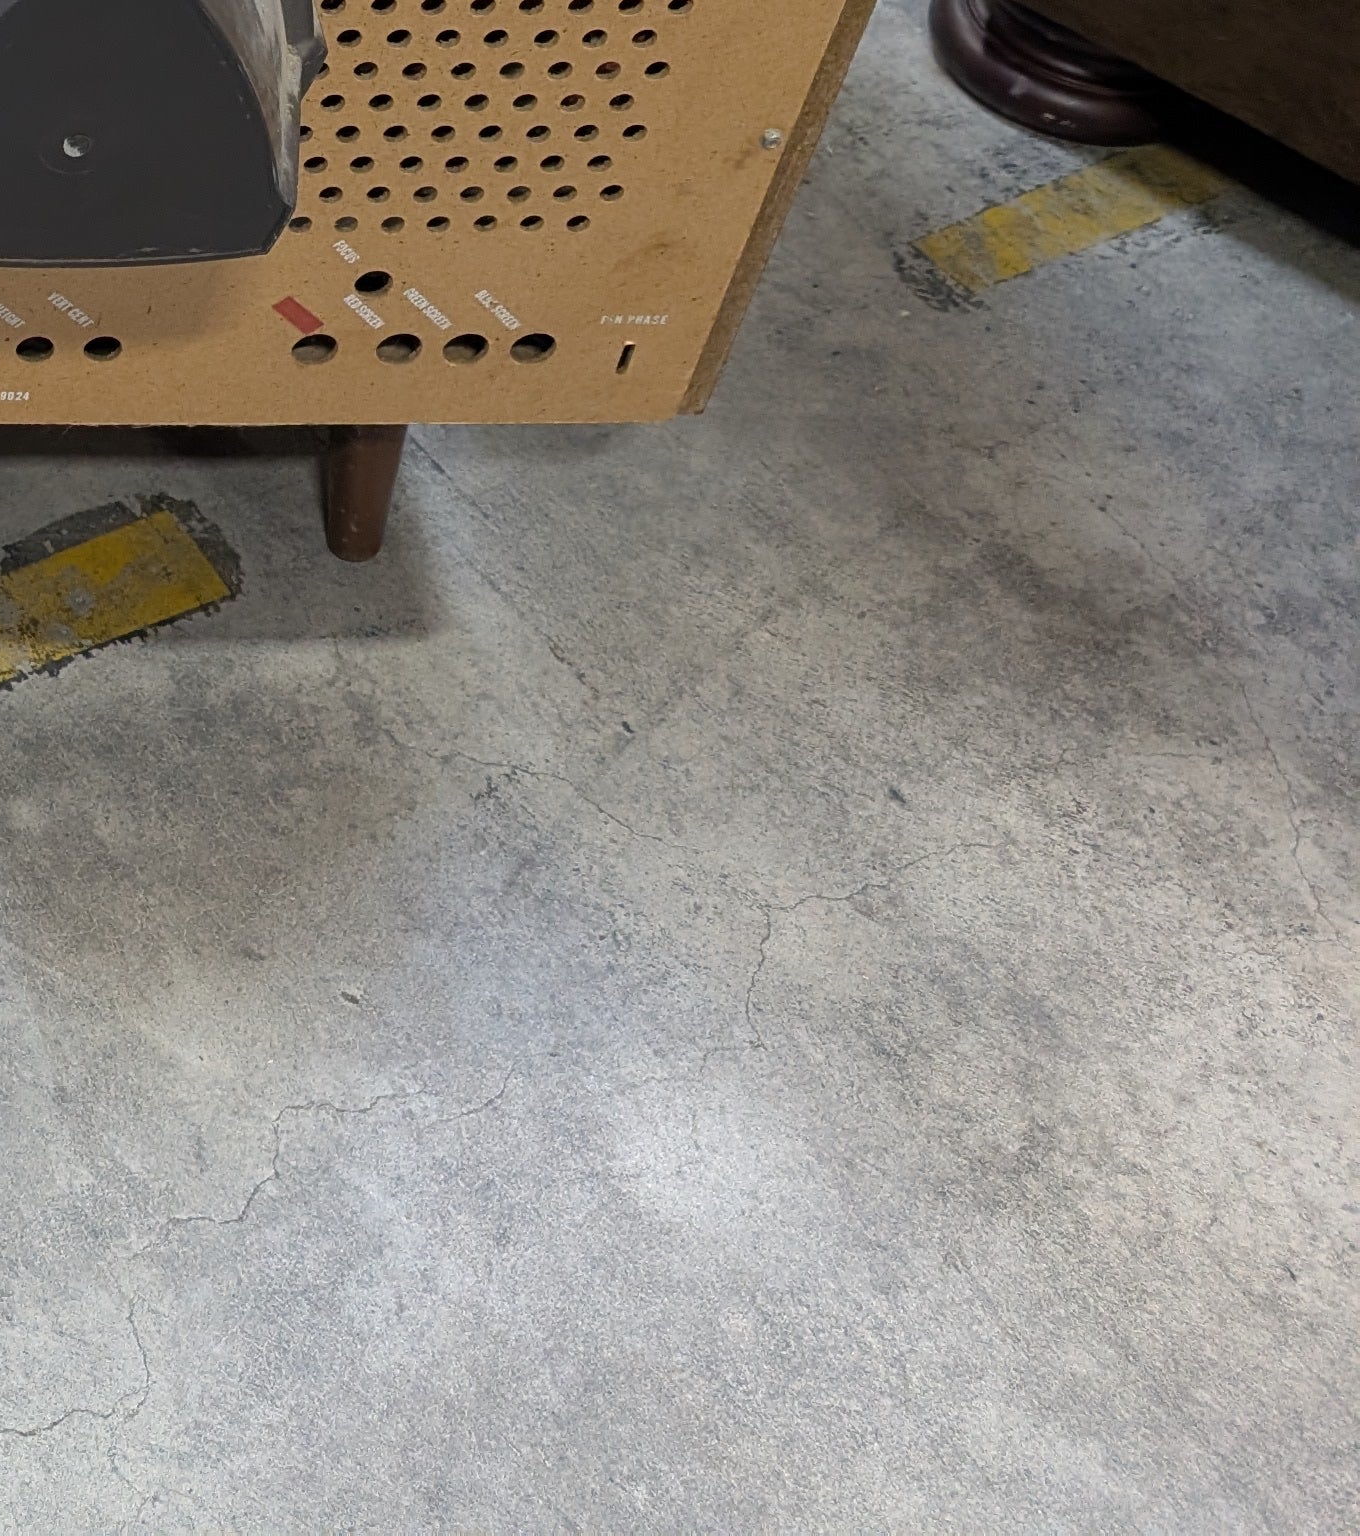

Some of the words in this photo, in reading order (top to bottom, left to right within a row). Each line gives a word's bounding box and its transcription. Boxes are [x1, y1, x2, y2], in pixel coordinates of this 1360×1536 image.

[332, 239, 360, 264] FOCUS
[47, 291, 74, 311] VERT
[67, 307, 95, 328] CENT
[343, 294, 361, 310] RED
[355, 304, 386, 330] SCREEN
[402, 287, 431, 311] GREEN
[422, 305, 454, 331] SCREEN
[492, 304, 521, 331] SCREEN
[627, 314, 669, 325] PHASE
